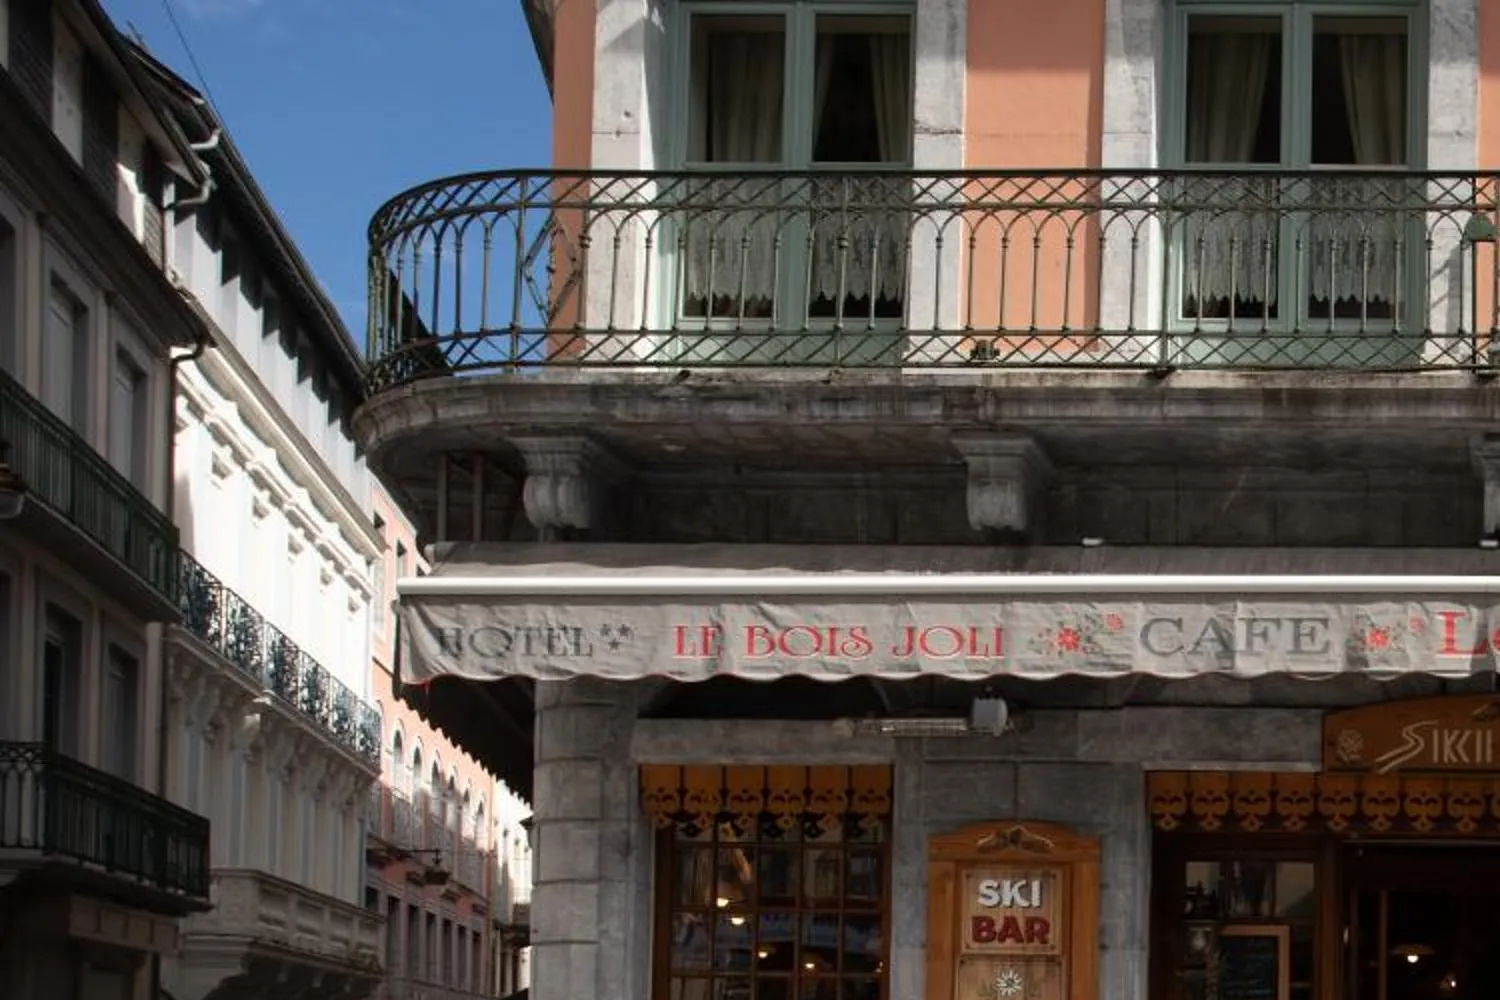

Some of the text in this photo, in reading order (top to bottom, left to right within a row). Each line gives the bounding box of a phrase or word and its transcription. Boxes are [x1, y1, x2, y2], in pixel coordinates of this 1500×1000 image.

[434, 624, 594, 660] HOTEL
[672, 625, 1004, 659] LE BOIS JOLI
[1139, 616, 1331, 658] CAFE
[977, 878, 1043, 908] SKI
[970, 914, 1051, 945] BAR
